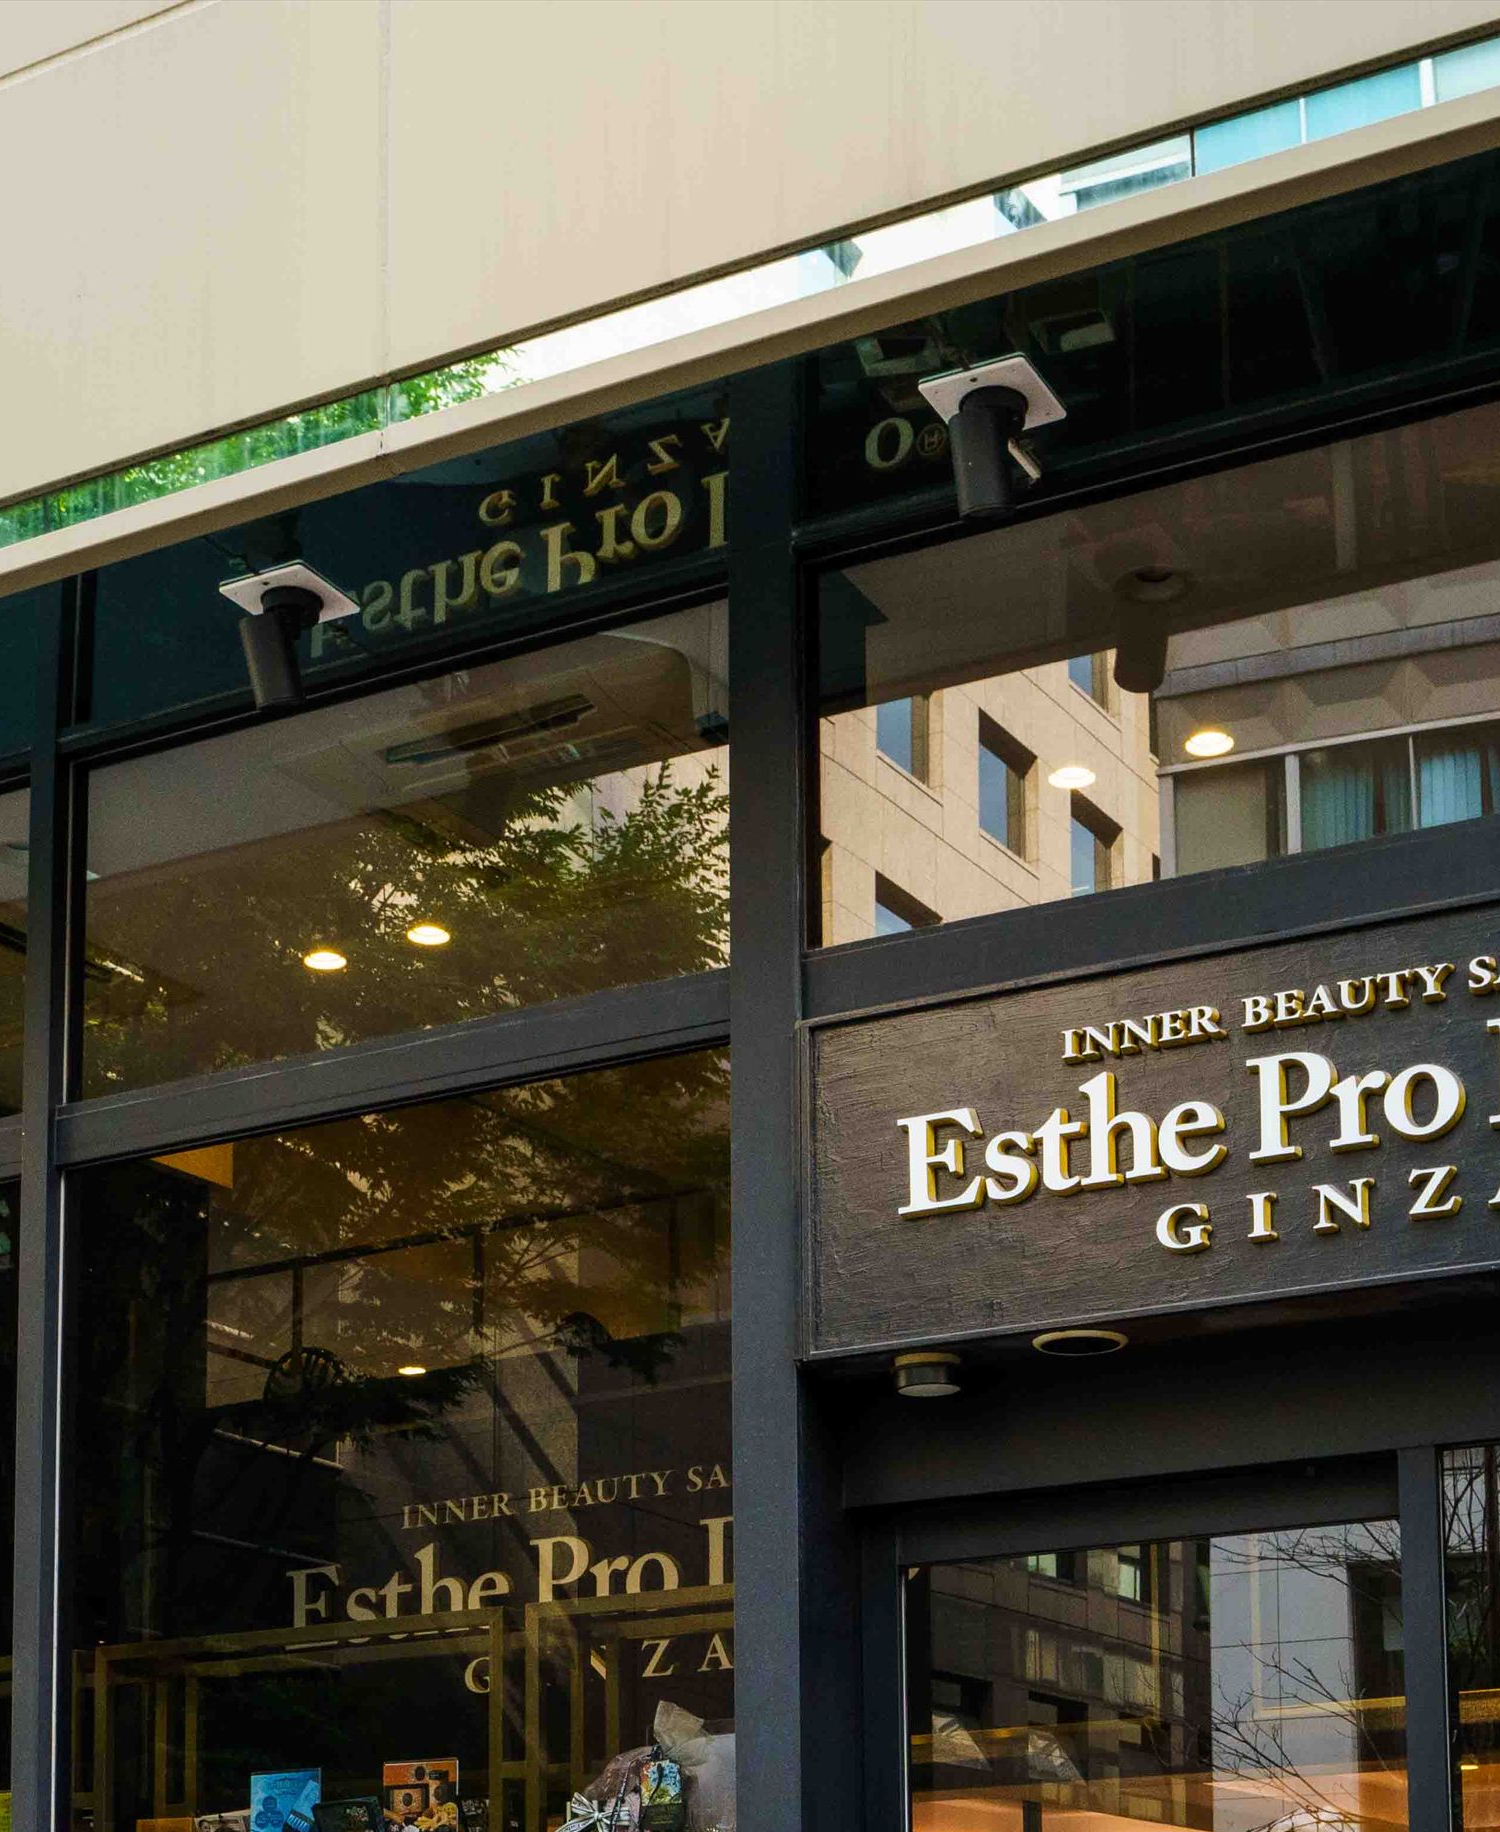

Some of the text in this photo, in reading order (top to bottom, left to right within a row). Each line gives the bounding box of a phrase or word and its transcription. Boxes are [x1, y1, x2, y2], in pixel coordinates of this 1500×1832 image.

[1062, 1002, 1223, 1066] INNER
[1241, 963, 1452, 1032] BEAUTY
[897, 1071, 1228, 1221] Esthe
[1248, 1052, 1467, 1163] Pro
[401, 1496, 511, 1531] INNER
[527, 1470, 671, 1514] BEAUTY
[285, 1542, 511, 1650] Esthe
[530, 1535, 679, 1613] Pro
